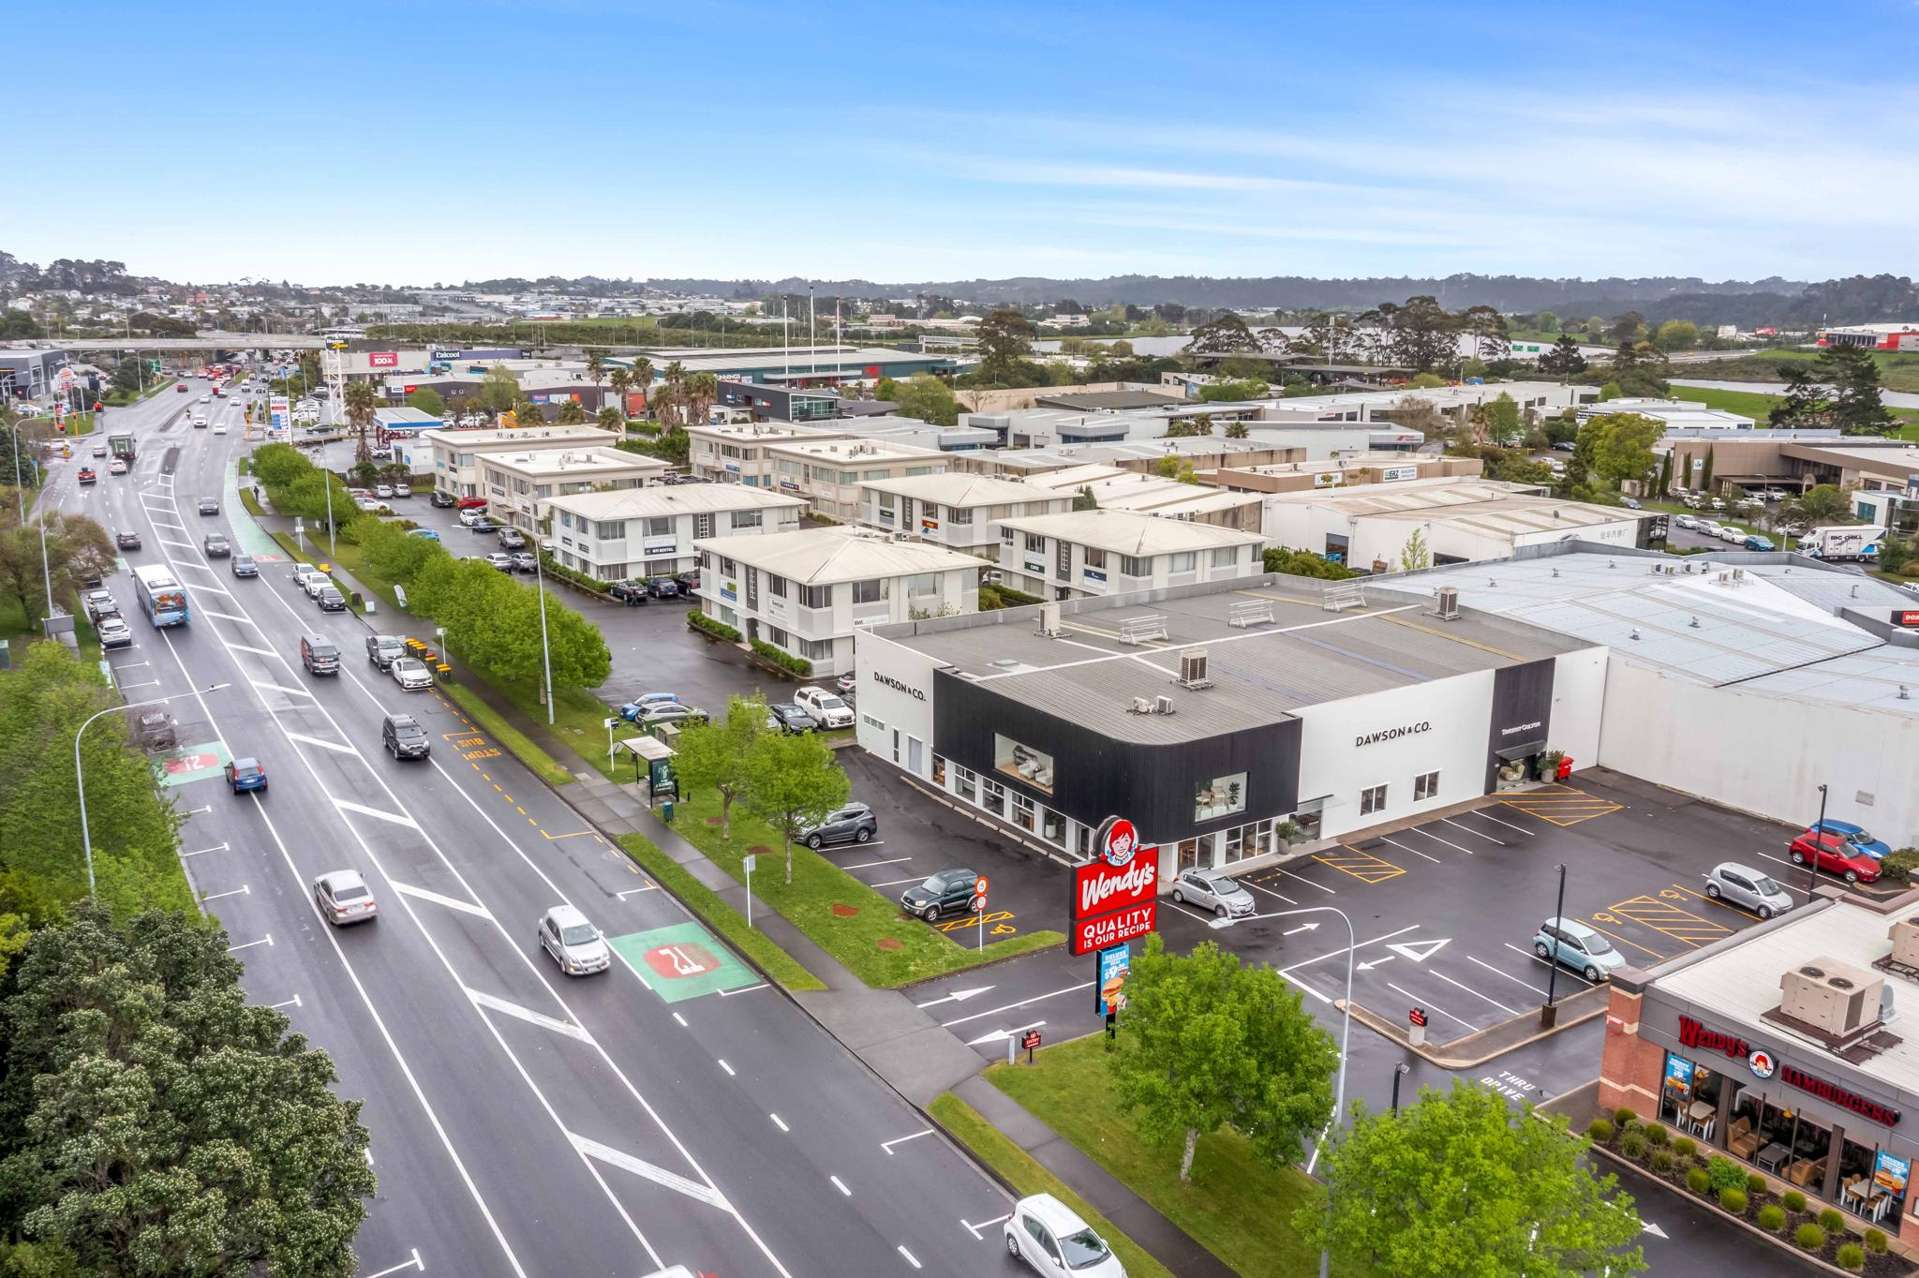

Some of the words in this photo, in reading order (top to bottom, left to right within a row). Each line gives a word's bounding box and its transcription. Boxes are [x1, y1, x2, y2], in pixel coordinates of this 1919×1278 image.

[1082, 860, 1155, 911] Wendy's
[1083, 907, 1152, 939] QUALITY
[1083, 938, 1093, 949] IS
[1095, 931, 1115, 945] OUR
[1117, 921, 1151, 939] RECIPE
[1480, 1076, 1525, 1101] DRIVE
[1499, 1070, 1536, 1091] THRU
[1780, 1064, 1901, 1128] HAMBURGERS
